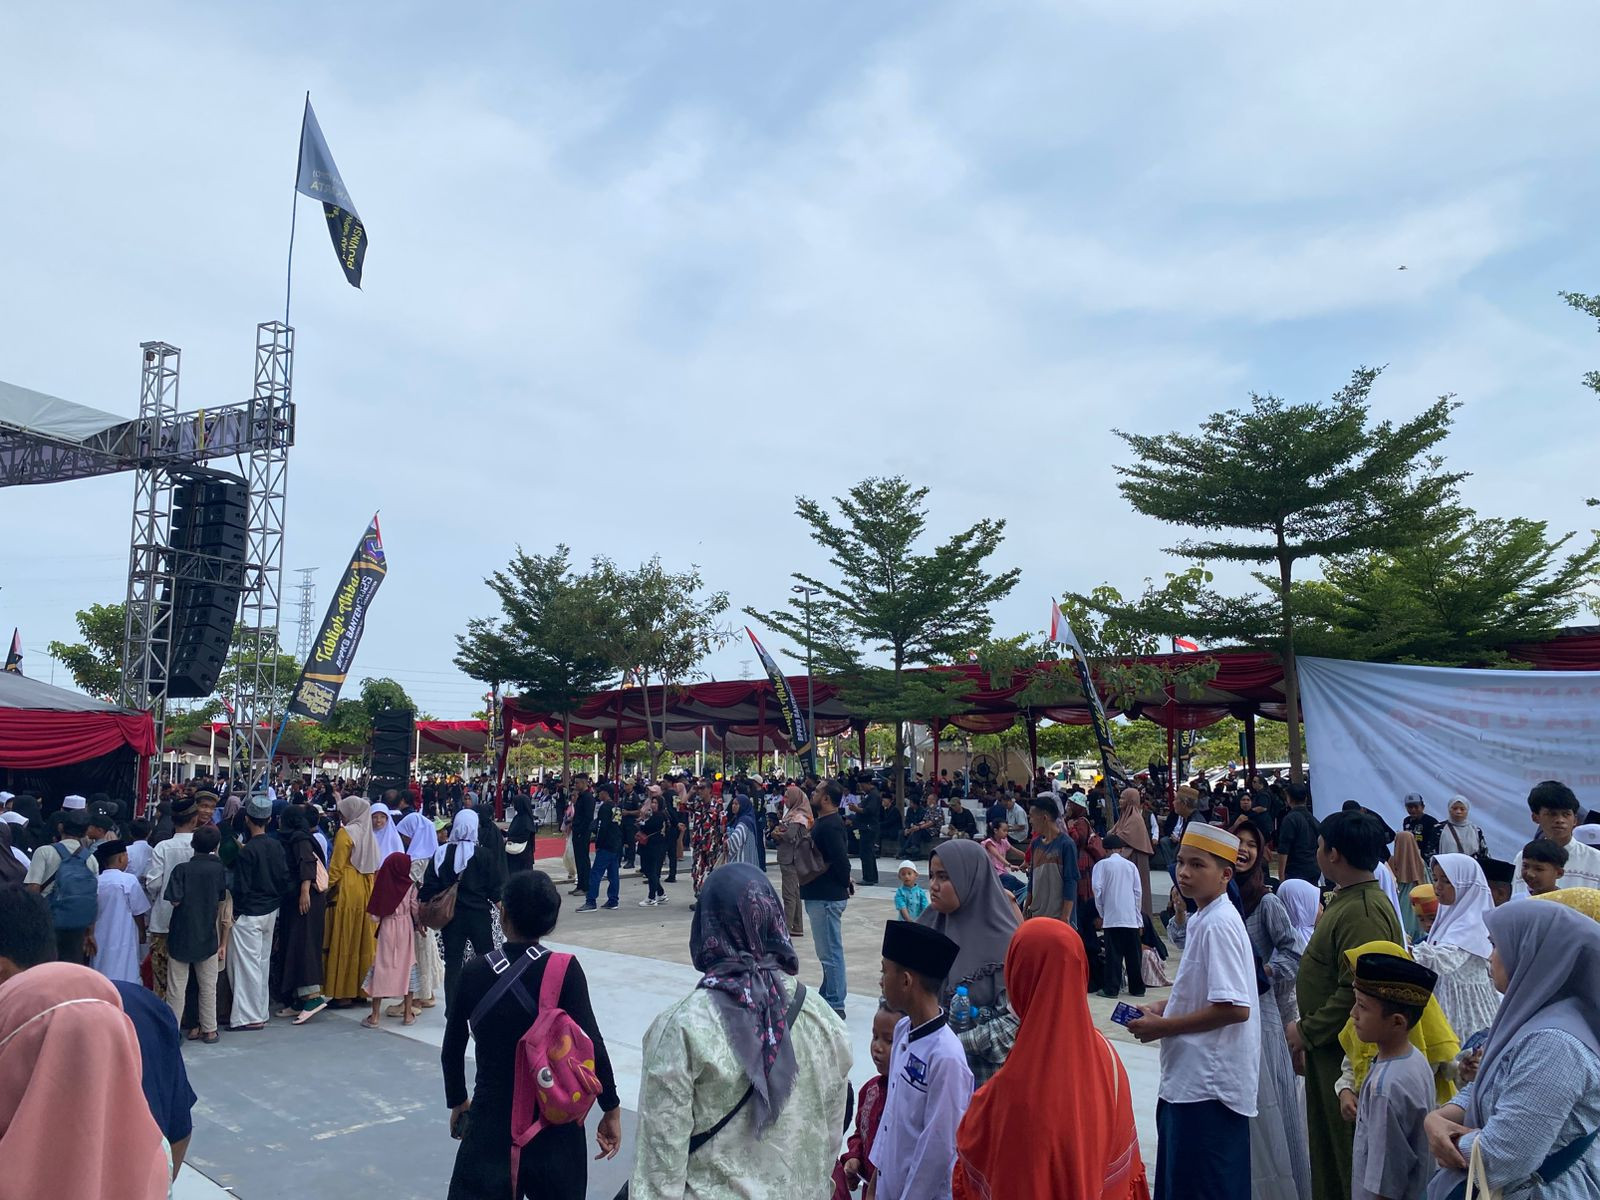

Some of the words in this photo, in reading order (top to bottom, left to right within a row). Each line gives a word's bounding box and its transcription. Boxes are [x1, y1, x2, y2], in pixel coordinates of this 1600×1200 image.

[315, 615, 346, 662] Tabligh
[338, 570, 361, 614] Akbar
[335, 638, 351, 669] BPPKB
[345, 604, 363, 640] BANTEN
